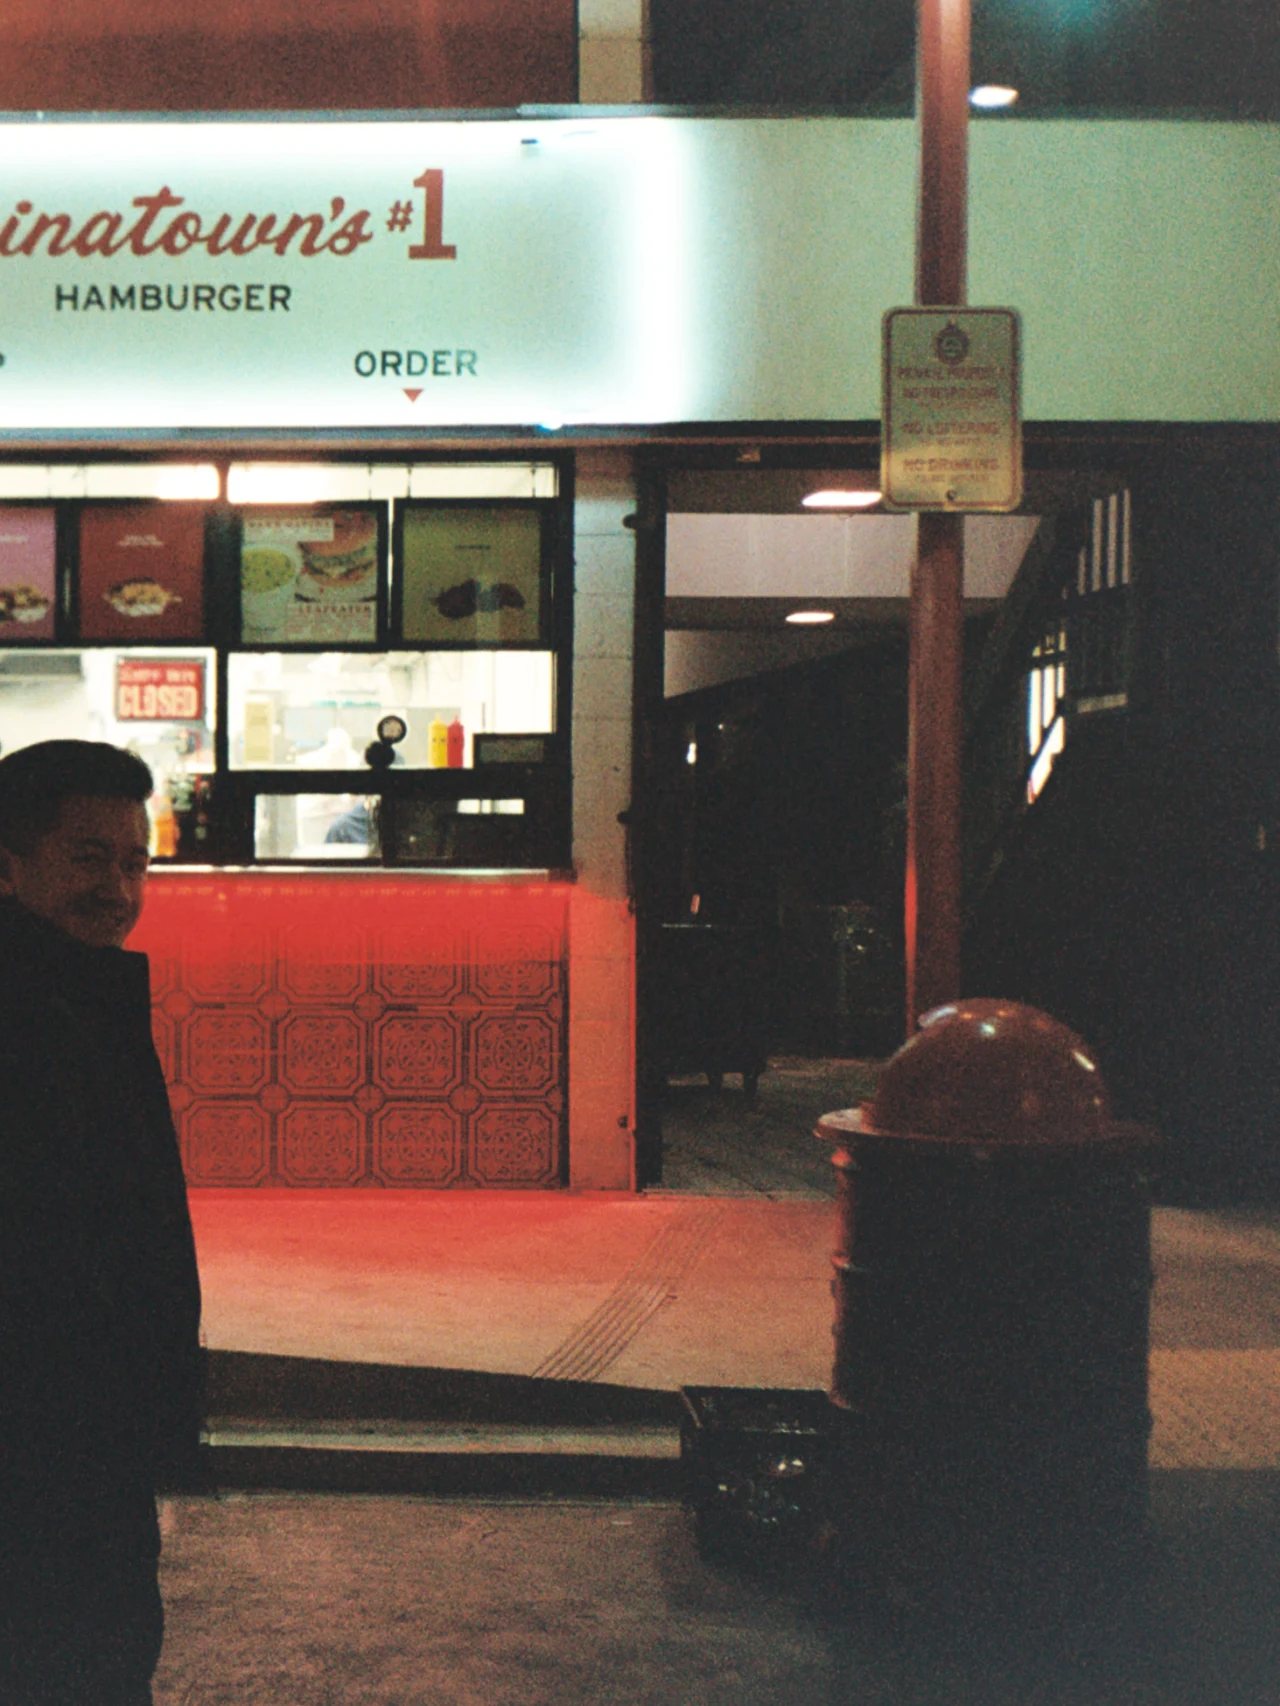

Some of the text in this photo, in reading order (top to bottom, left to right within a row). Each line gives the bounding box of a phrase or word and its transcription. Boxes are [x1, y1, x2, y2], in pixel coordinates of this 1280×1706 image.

[386, 167, 457, 260] #1
[54, 284, 292, 312] HAMBURGER
[353, 350, 478, 378] ORDER
[903, 458, 924, 471] NO
[119, 684, 198, 718] CLOSED
